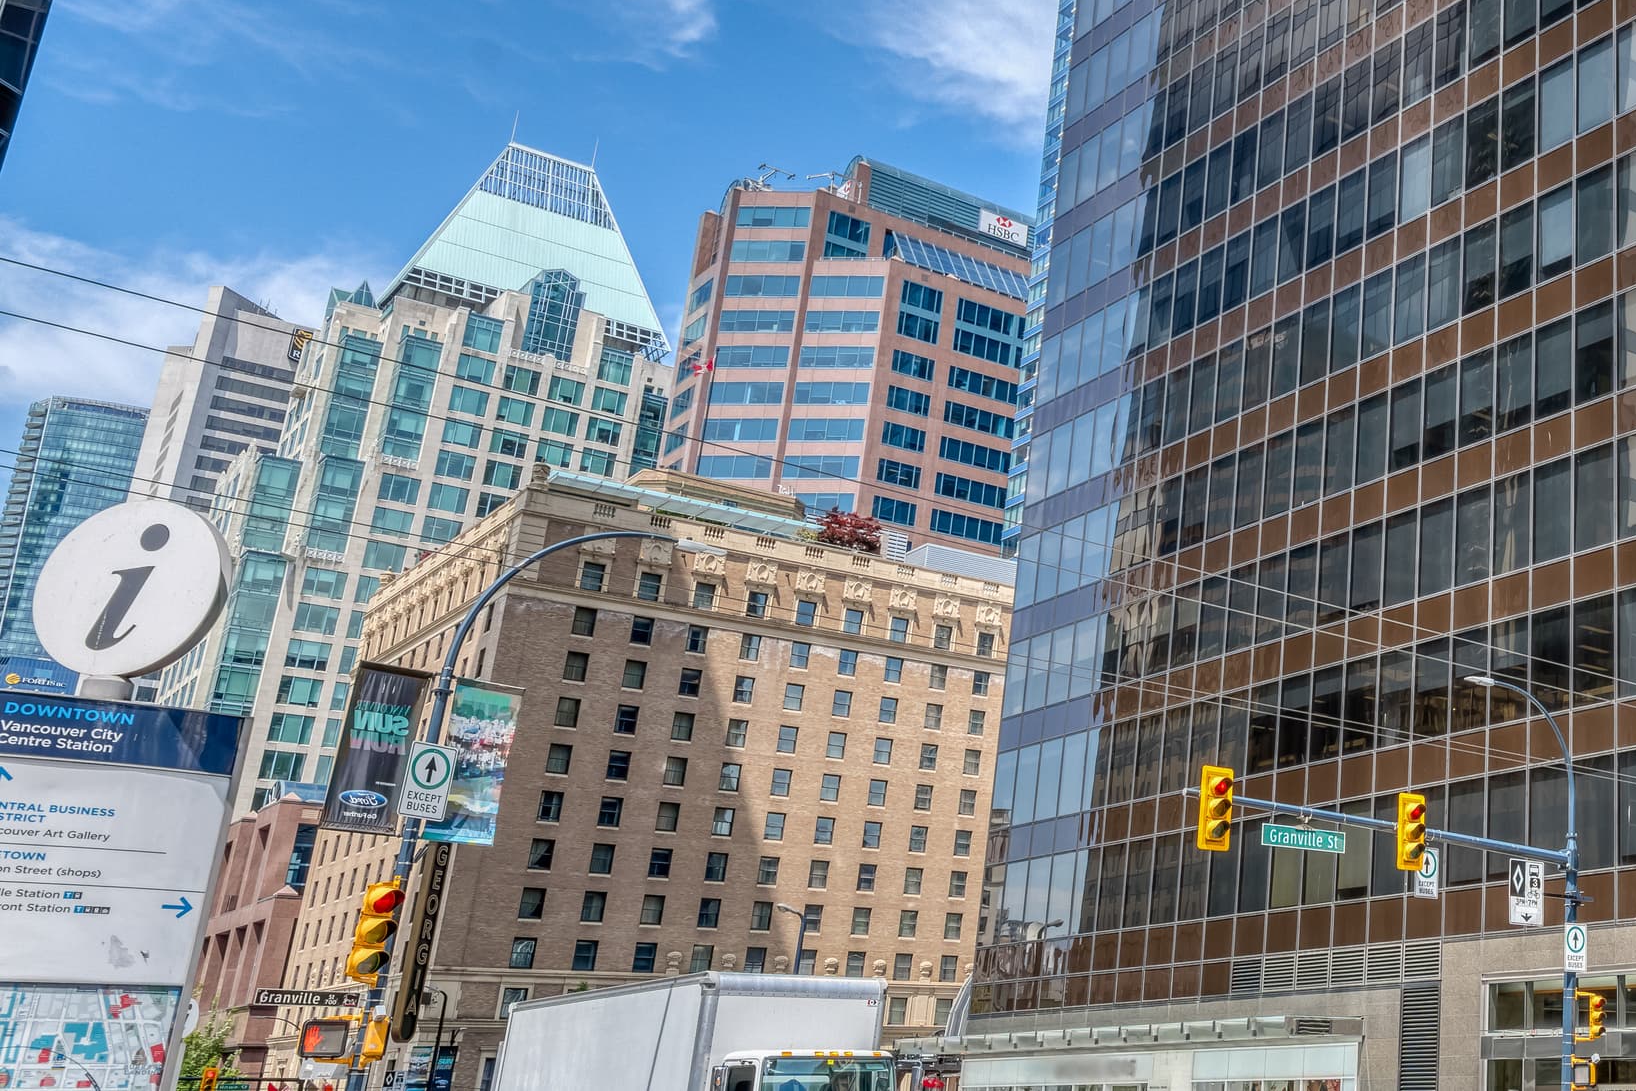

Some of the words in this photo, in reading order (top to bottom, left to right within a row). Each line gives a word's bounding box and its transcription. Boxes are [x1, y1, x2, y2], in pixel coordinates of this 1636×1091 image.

[987, 223, 1020, 243] HSBC
[5, 701, 135, 726] DOWNTOWN
[0, 719, 87, 738] Vancouver
[90, 728, 123, 743] City
[0, 732, 52, 748] Centre
[55, 738, 113, 753] Station
[407, 790, 443, 803] EXCEPT
[49, 804, 116, 817] BUSINESS
[406, 801, 438, 814] BUSES
[43, 829, 63, 839] Art
[67, 831, 111, 843] Gallery
[1269, 828, 1323, 848] Granville
[1327, 836, 1339, 850] St
[0, 850, 47, 861] TOWN
[15, 865, 53, 876] Street
[56, 867, 102, 879] (shops)
[1418, 880, 1435, 888] EXCEPT
[1532, 878, 1538, 888] 3
[15, 888, 60, 899] Station
[1419, 887, 1434, 895] BUSES
[26, 903, 71, 913] Station
[404, 845, 449, 1016] GEORGIA
[1567, 954, 1584, 962] EXCEPT
[1568, 961, 1583, 969] BUSES
[260, 991, 320, 1005] Granville
[324, 998, 337, 1006] 700
